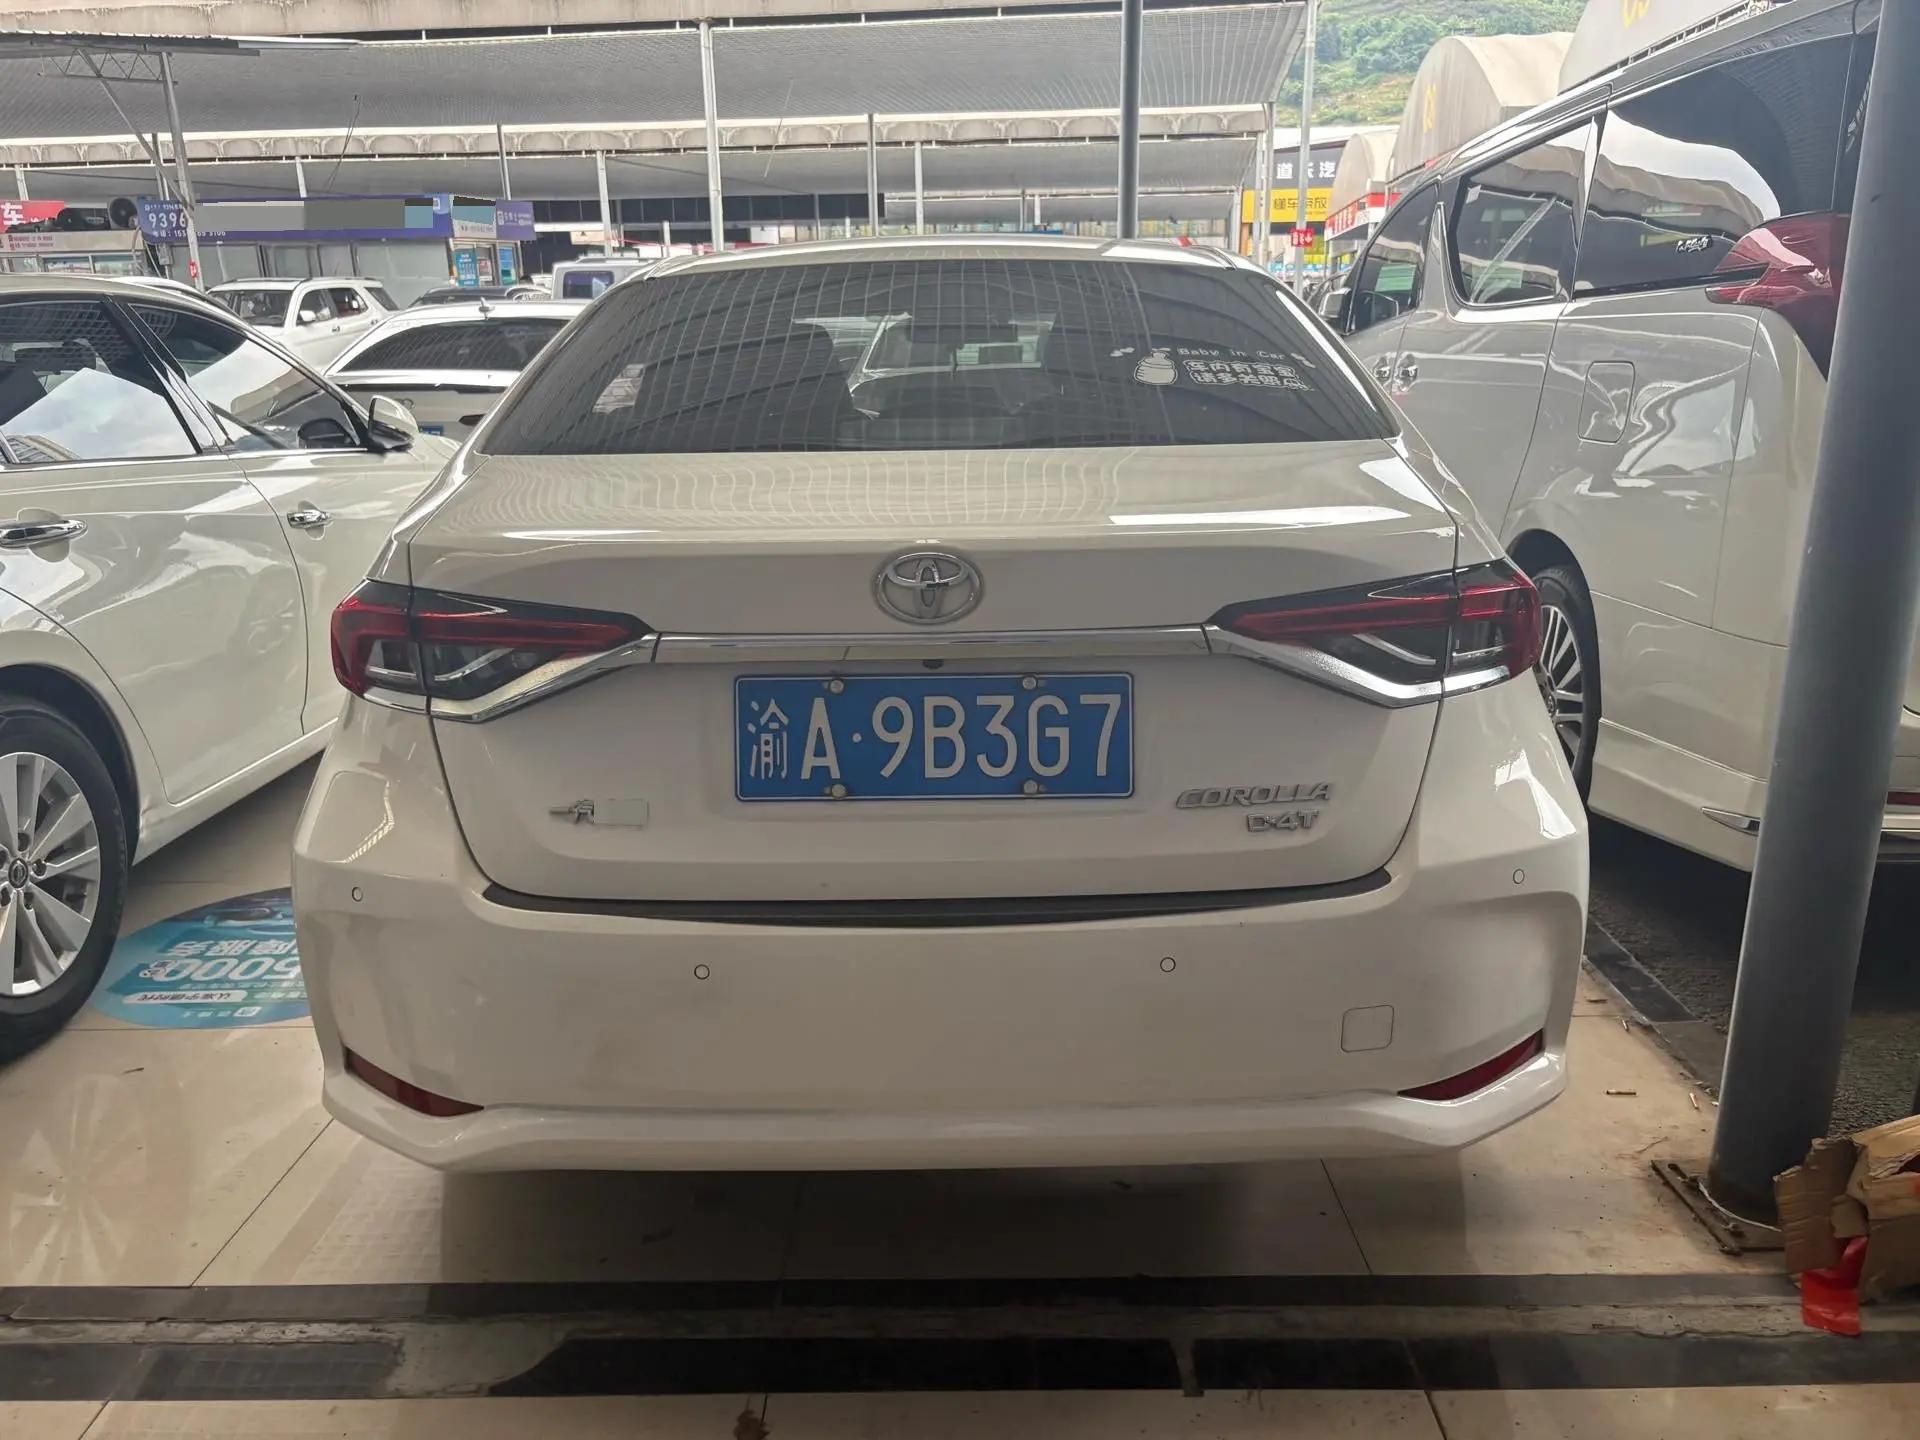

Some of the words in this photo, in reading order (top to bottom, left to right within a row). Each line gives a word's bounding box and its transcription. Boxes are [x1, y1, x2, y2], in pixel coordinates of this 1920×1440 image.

[1186, 361, 1295, 378] 车内有宝宝
[1176, 782, 1332, 809] COROLLA
[1246, 809, 1320, 833] D-4T
